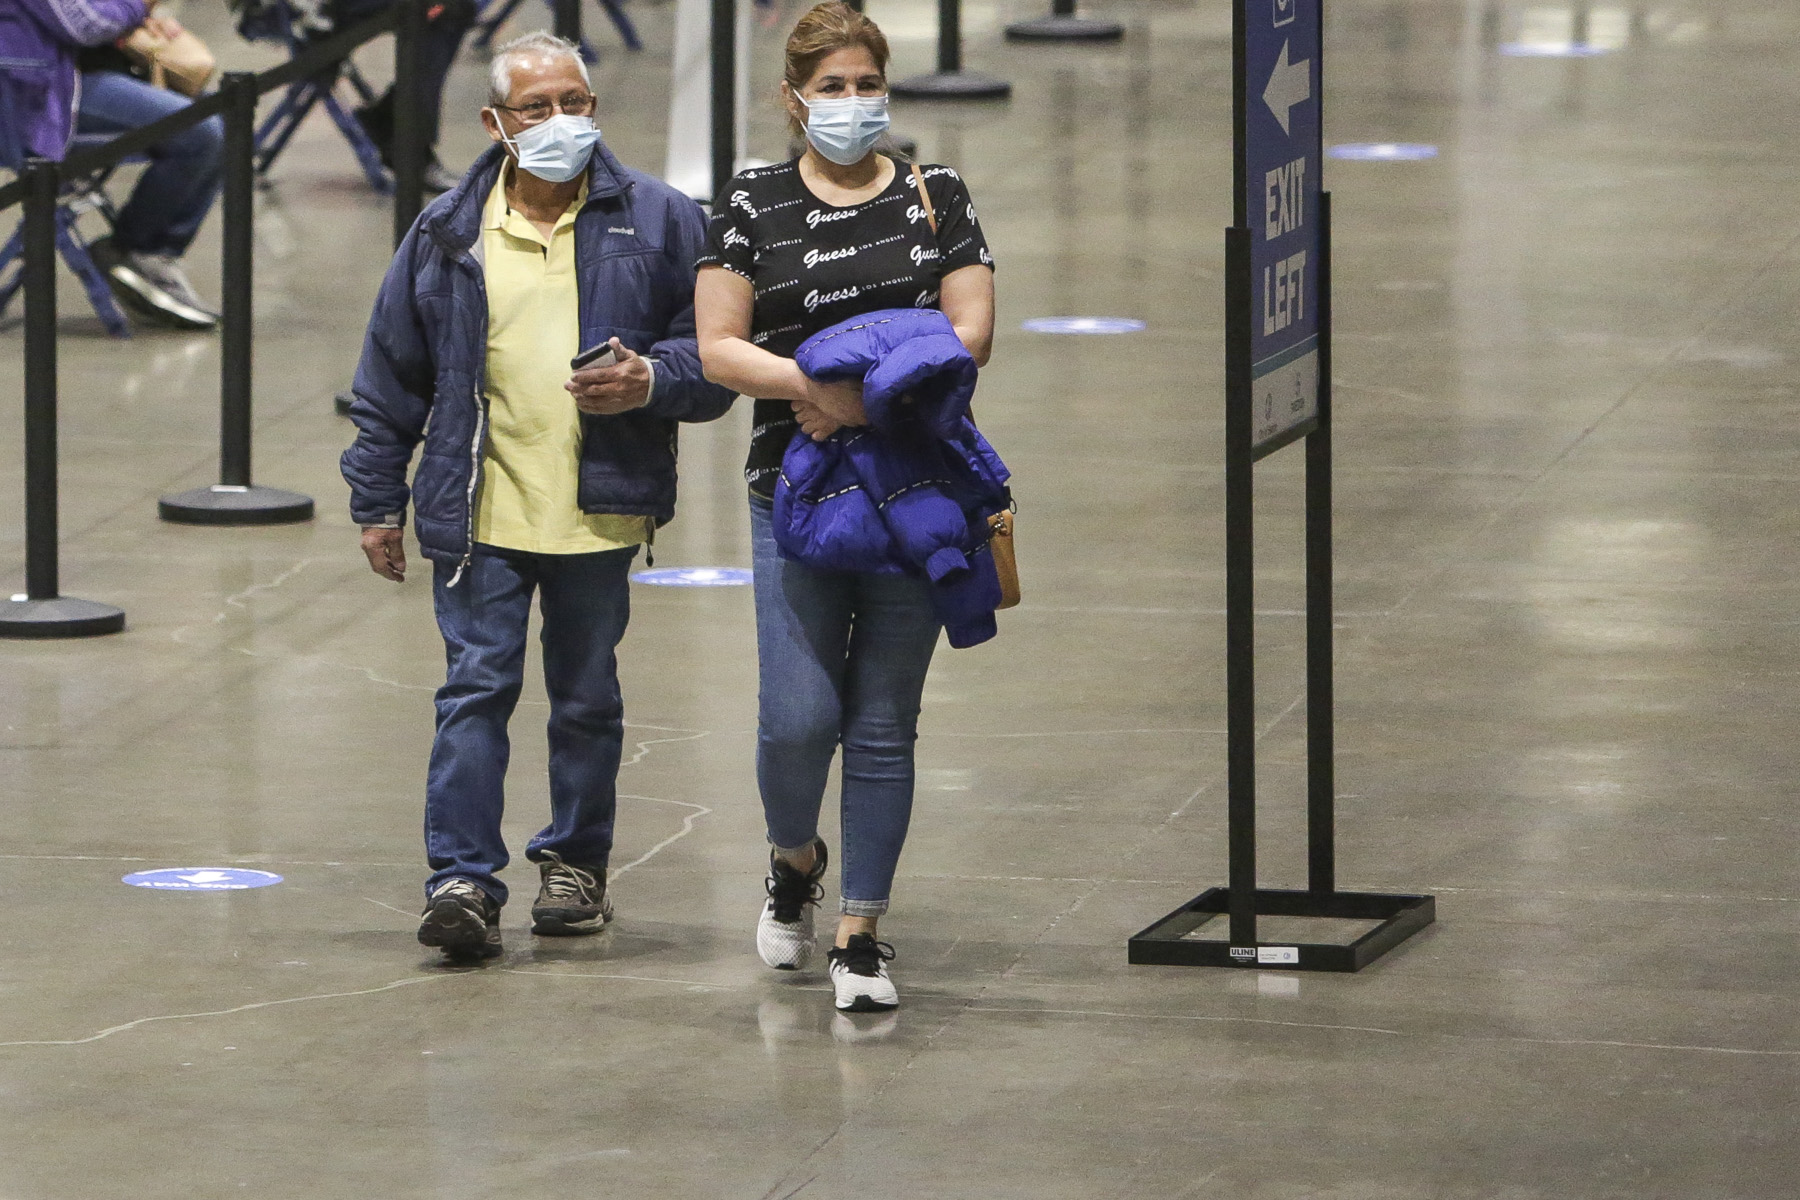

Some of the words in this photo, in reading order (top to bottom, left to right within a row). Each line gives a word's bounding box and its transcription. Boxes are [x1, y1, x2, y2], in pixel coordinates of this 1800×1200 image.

[806, 209, 859, 230] Guess
[875, 194, 904, 205] ANGELES
[1265, 156, 1306, 242] EXIT
[772, 238, 803, 248] ANGELES
[803, 248, 858, 269] Guess
[875, 233, 905, 246] ANGELES
[768, 279, 799, 291] ANGELES
[804, 289, 860, 313] Guess
[861, 283, 877, 291] LOS
[881, 275, 913, 287] ANGELES
[1263, 250, 1306, 337] LEFT
[1231, 948, 1255, 956] ULINE
